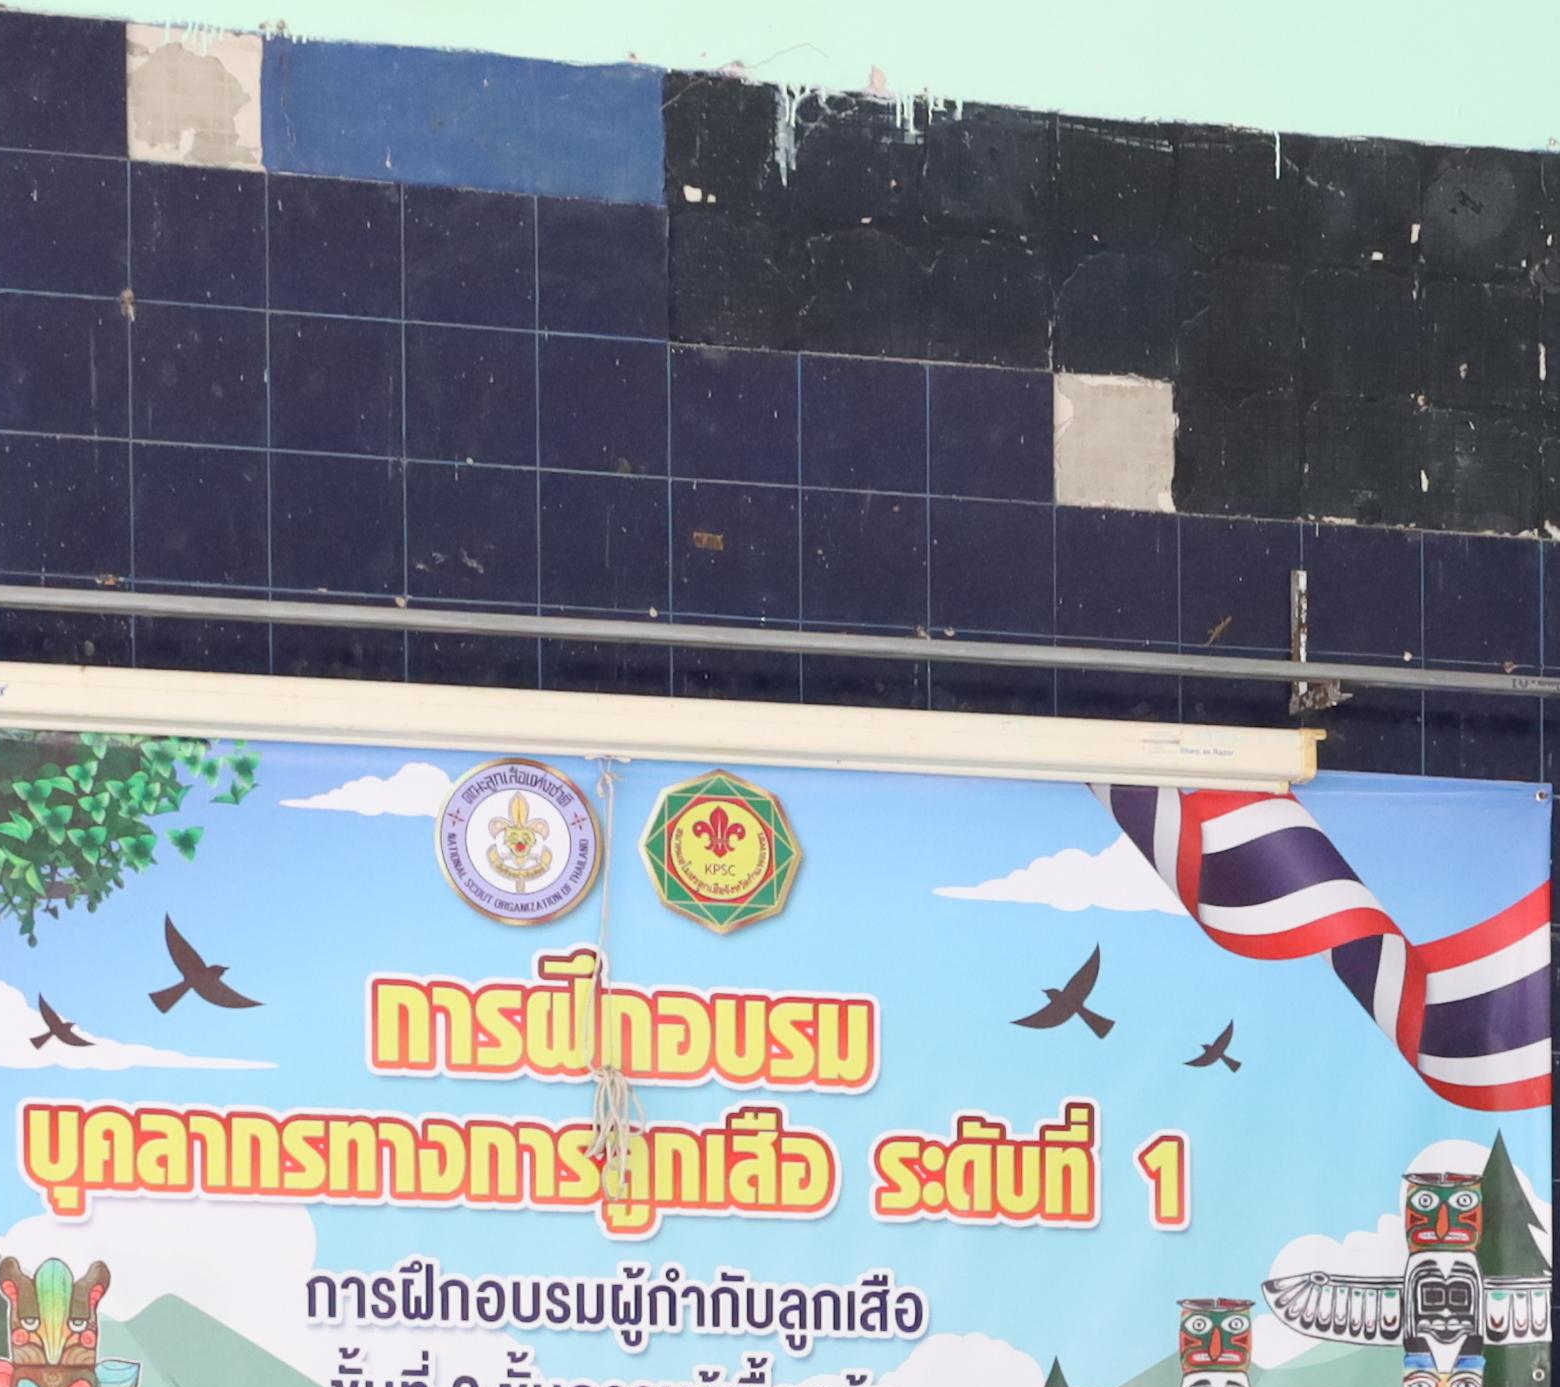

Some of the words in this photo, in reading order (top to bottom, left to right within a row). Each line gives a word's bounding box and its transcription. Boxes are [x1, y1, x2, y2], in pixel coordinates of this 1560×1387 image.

[447, 832, 468, 880] NATIONAL
[464, 878, 494, 904] SCOUT
[493, 890, 563, 914] ORGANIZATION
[560, 883, 573, 897] OF
[568, 838, 589, 885] THAILAND
[704, 863, 736, 877] KPSC
[371, 949, 875, 1086] การฝึกอบรม
[23, 1104, 836, 1234] บุคลากรทางการลูกเสือ
[873, 1103, 1096, 1223] ระดับที่
[1139, 1135, 1185, 1224] 1
[306, 1260, 924, 1352] การฝึกอบรมผู้กำกับลูกเสือ
